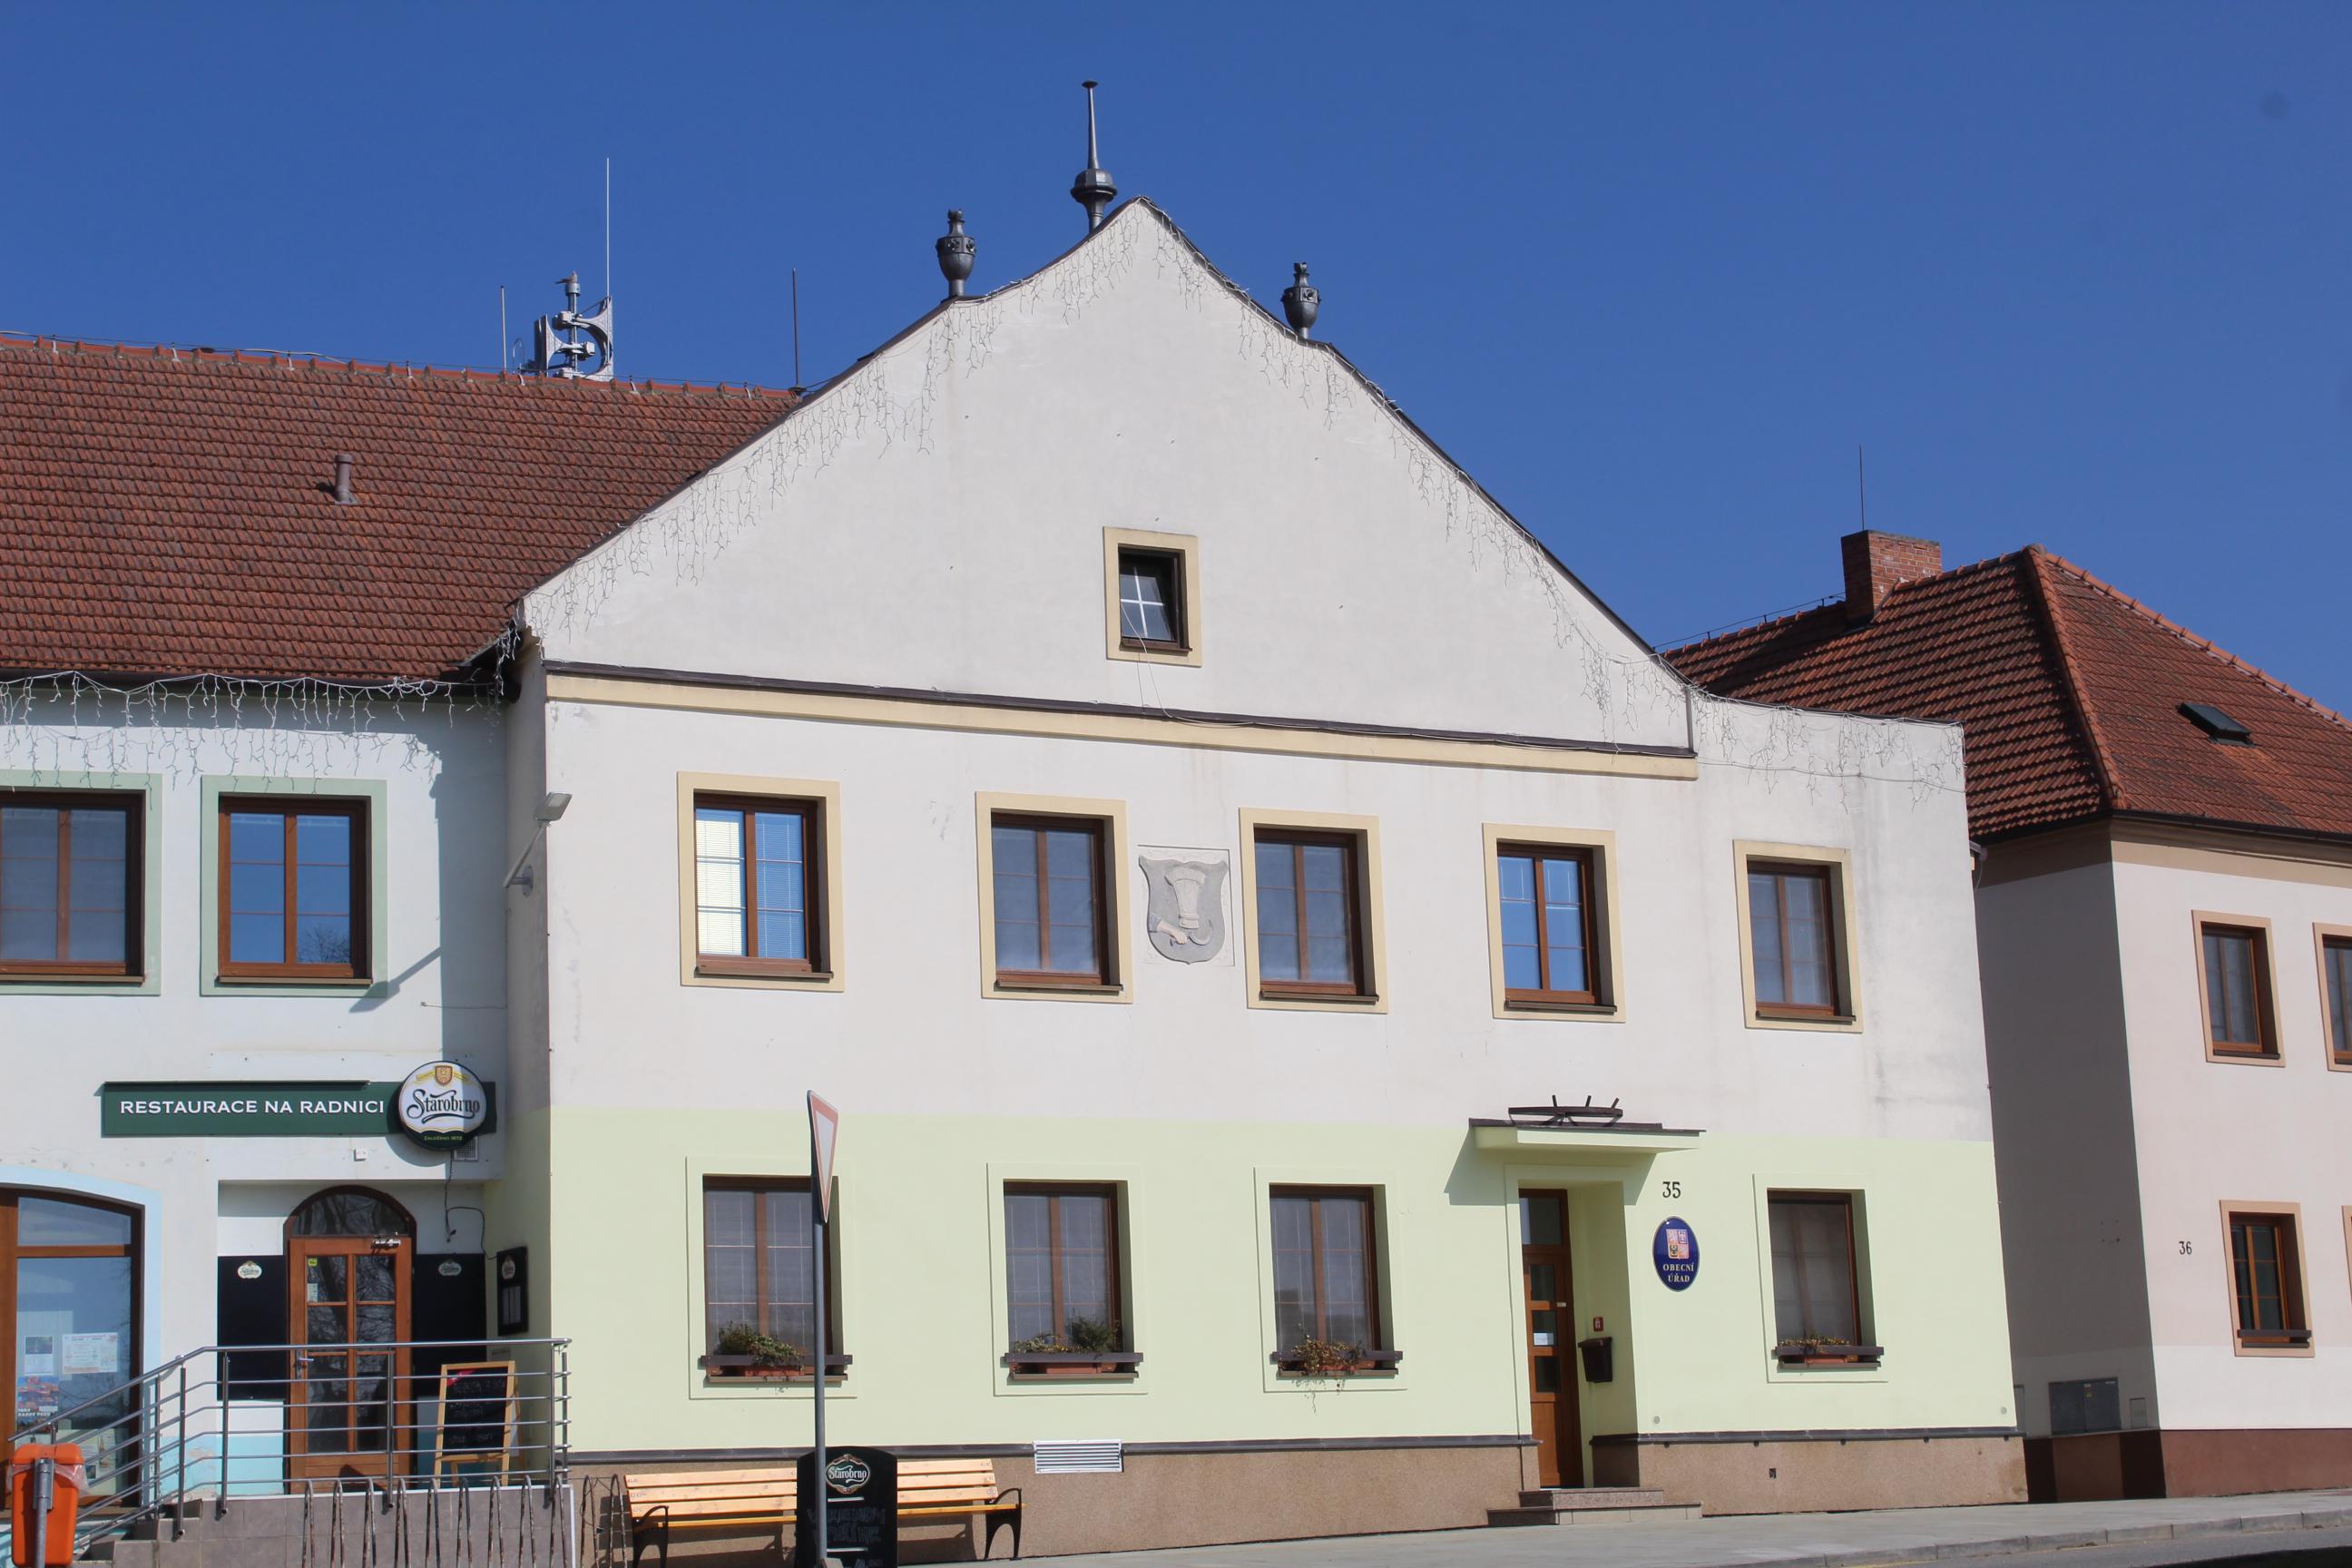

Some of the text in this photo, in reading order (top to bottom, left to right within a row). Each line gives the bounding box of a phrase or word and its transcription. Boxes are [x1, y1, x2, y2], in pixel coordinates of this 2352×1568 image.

[121, 1100, 384, 1114] RESTAURACE NA RADNICI
[407, 1089, 480, 1124] Starobrno
[1662, 1181, 1681, 1199] 35
[2179, 1240, 2192, 1255] 36
[1662, 1261, 1694, 1272] OBECNÍ
[1668, 1273, 1690, 1282] ÚŘAD
[828, 1465, 867, 1484] Starobrno
